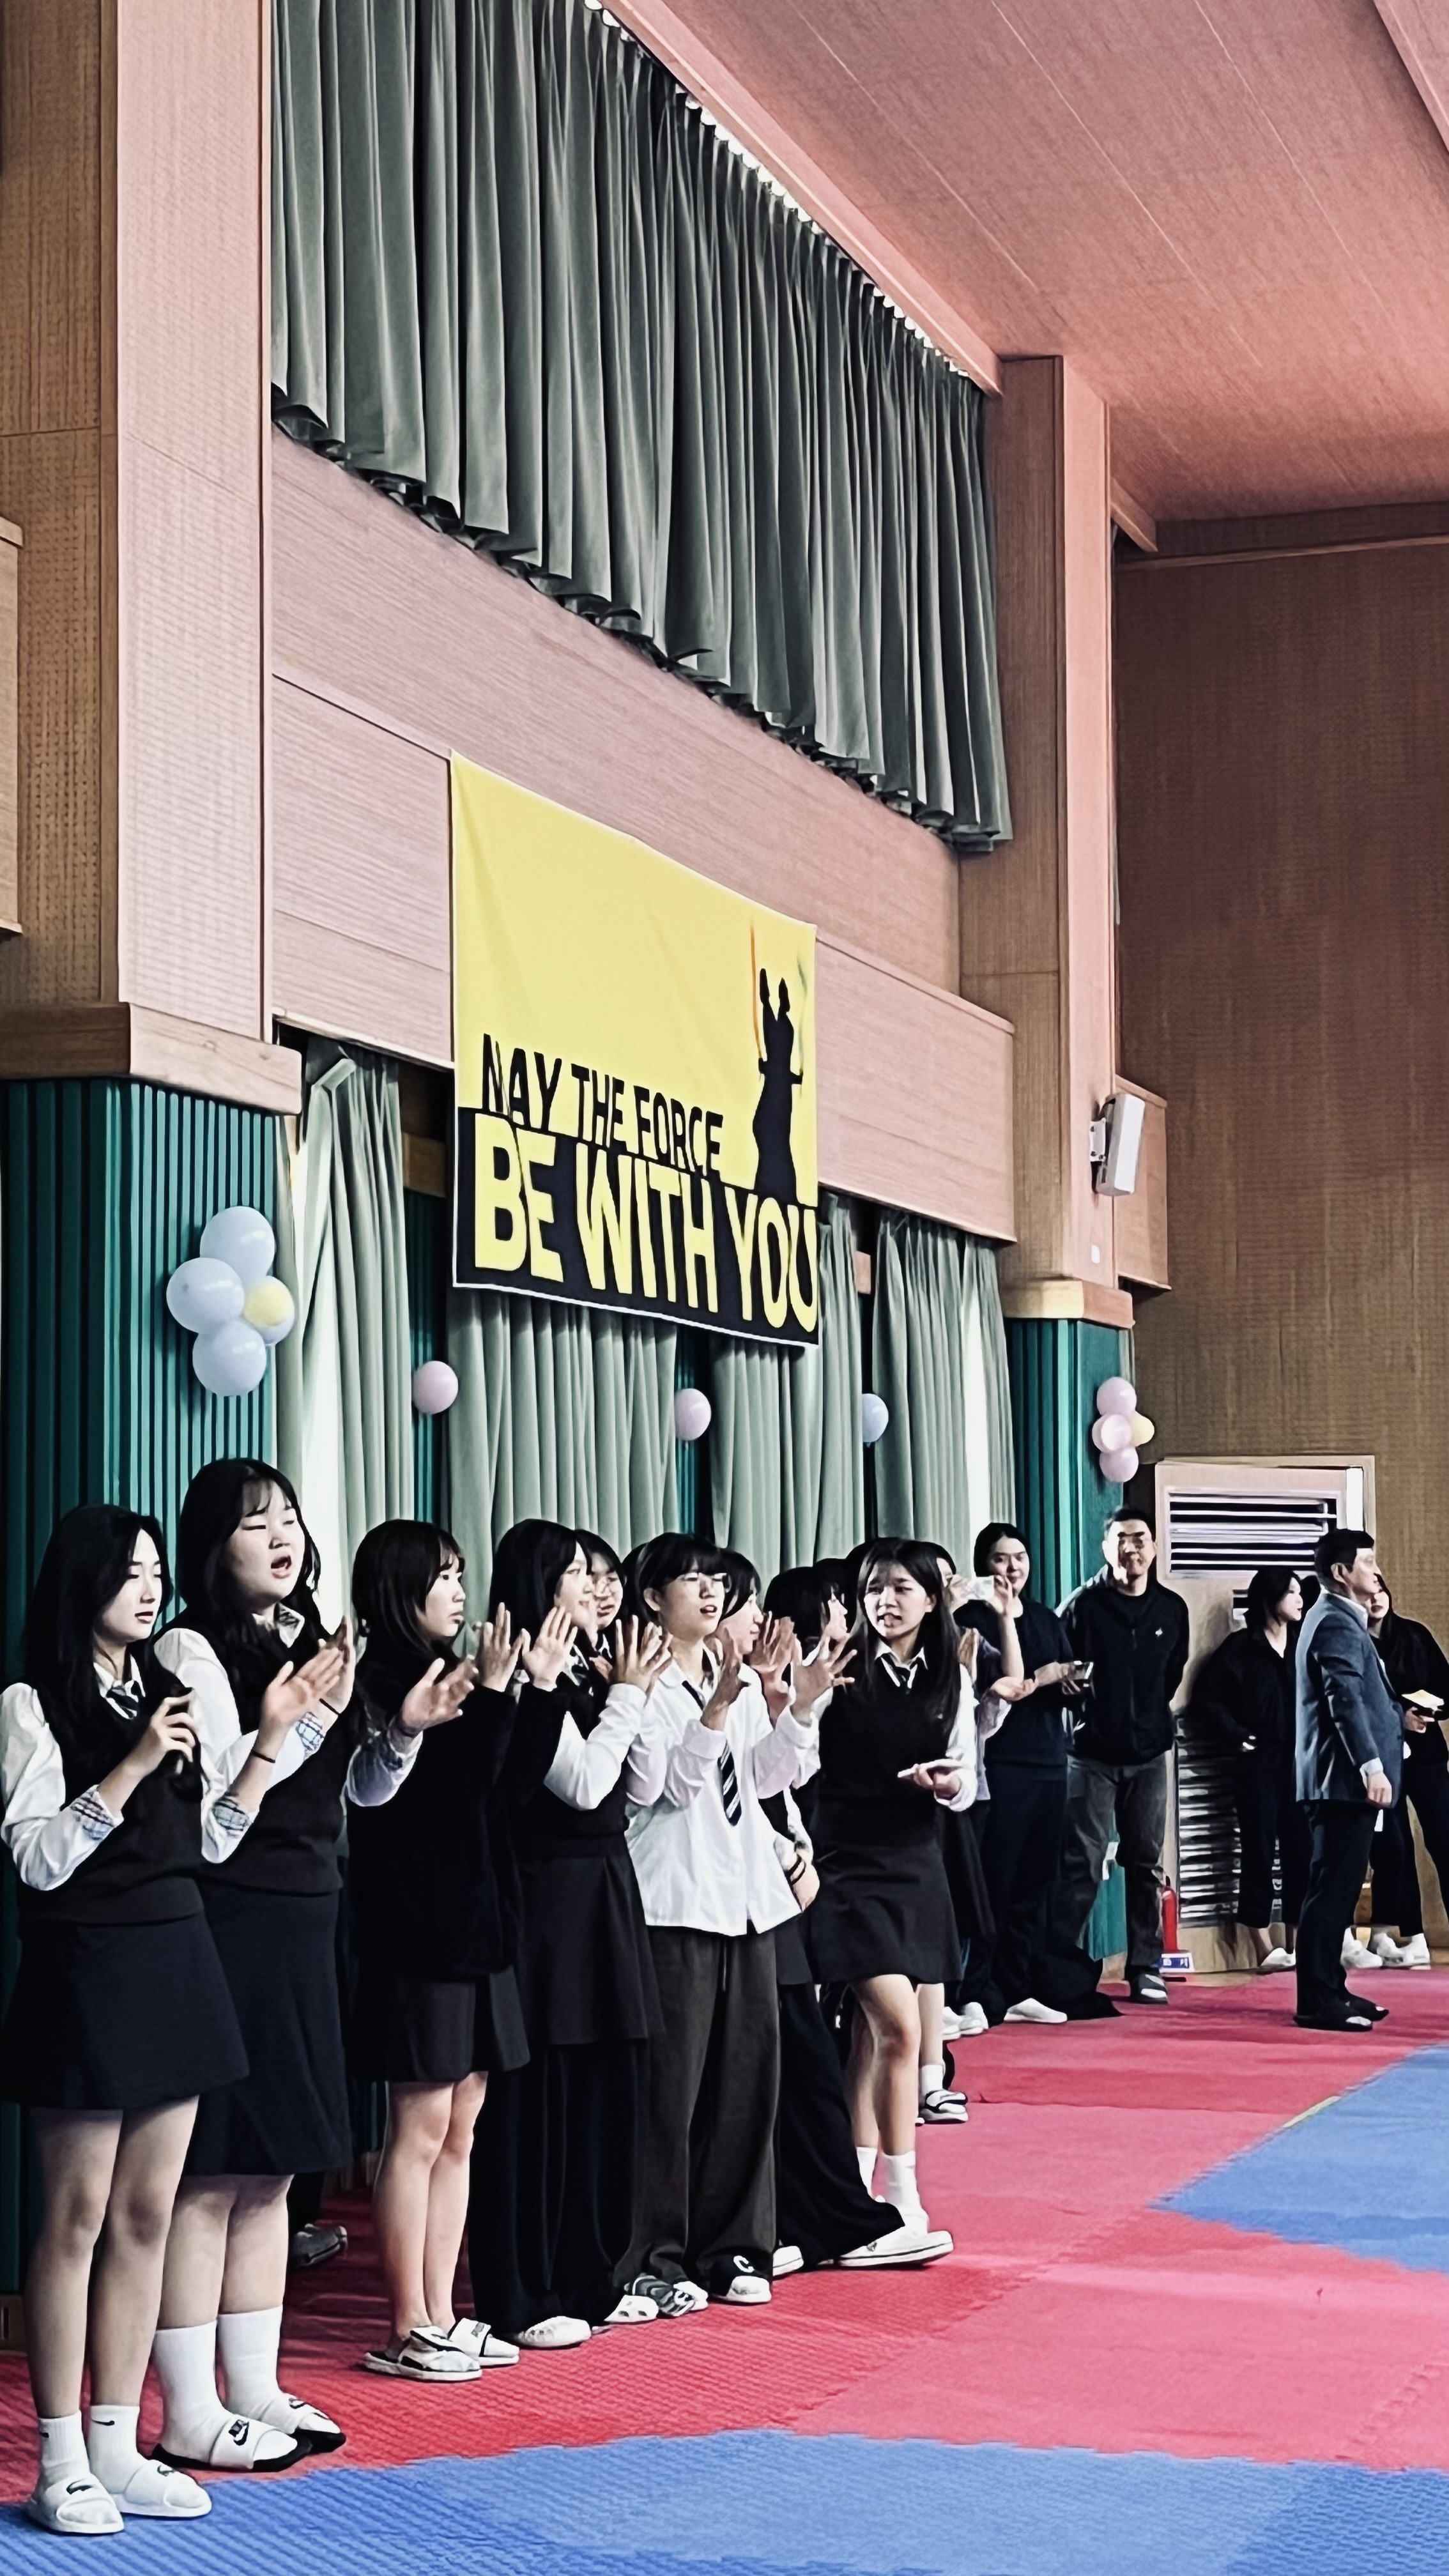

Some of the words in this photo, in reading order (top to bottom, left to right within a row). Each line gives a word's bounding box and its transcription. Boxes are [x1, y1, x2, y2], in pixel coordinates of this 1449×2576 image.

[571, 1063, 625, 1151] THE
[633, 1085, 723, 1181] FORCE
[475, 1112, 564, 1282] BE
[576, 1142, 718, 1313] WITH
[724, 1186, 818, 1333] YOU
